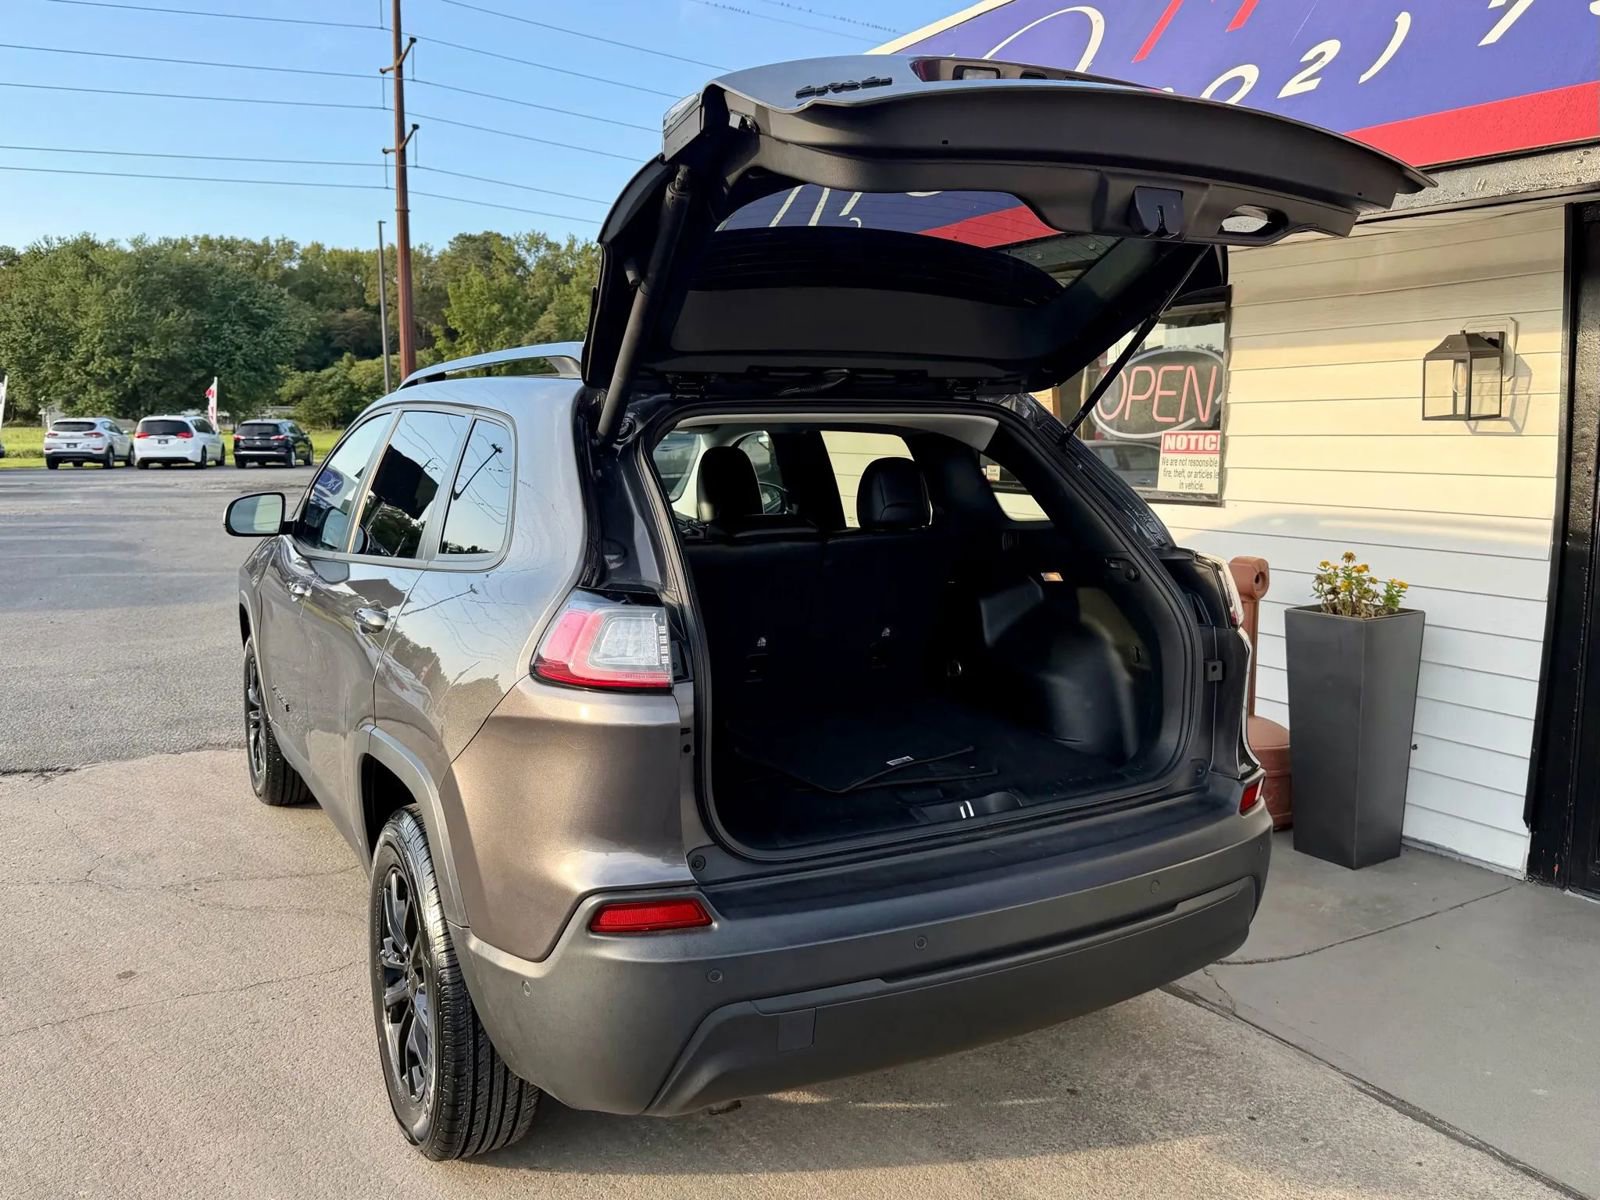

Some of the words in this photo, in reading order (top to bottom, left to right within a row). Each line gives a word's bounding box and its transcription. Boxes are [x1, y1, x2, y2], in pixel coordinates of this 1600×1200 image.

[1097, 365, 1217, 422] OPEN
[1164, 434, 1220, 451] NOTIC
[1179, 458, 1187, 467] not
[1188, 458, 1218, 468] responsible
[1194, 470, 1213, 479] articles
